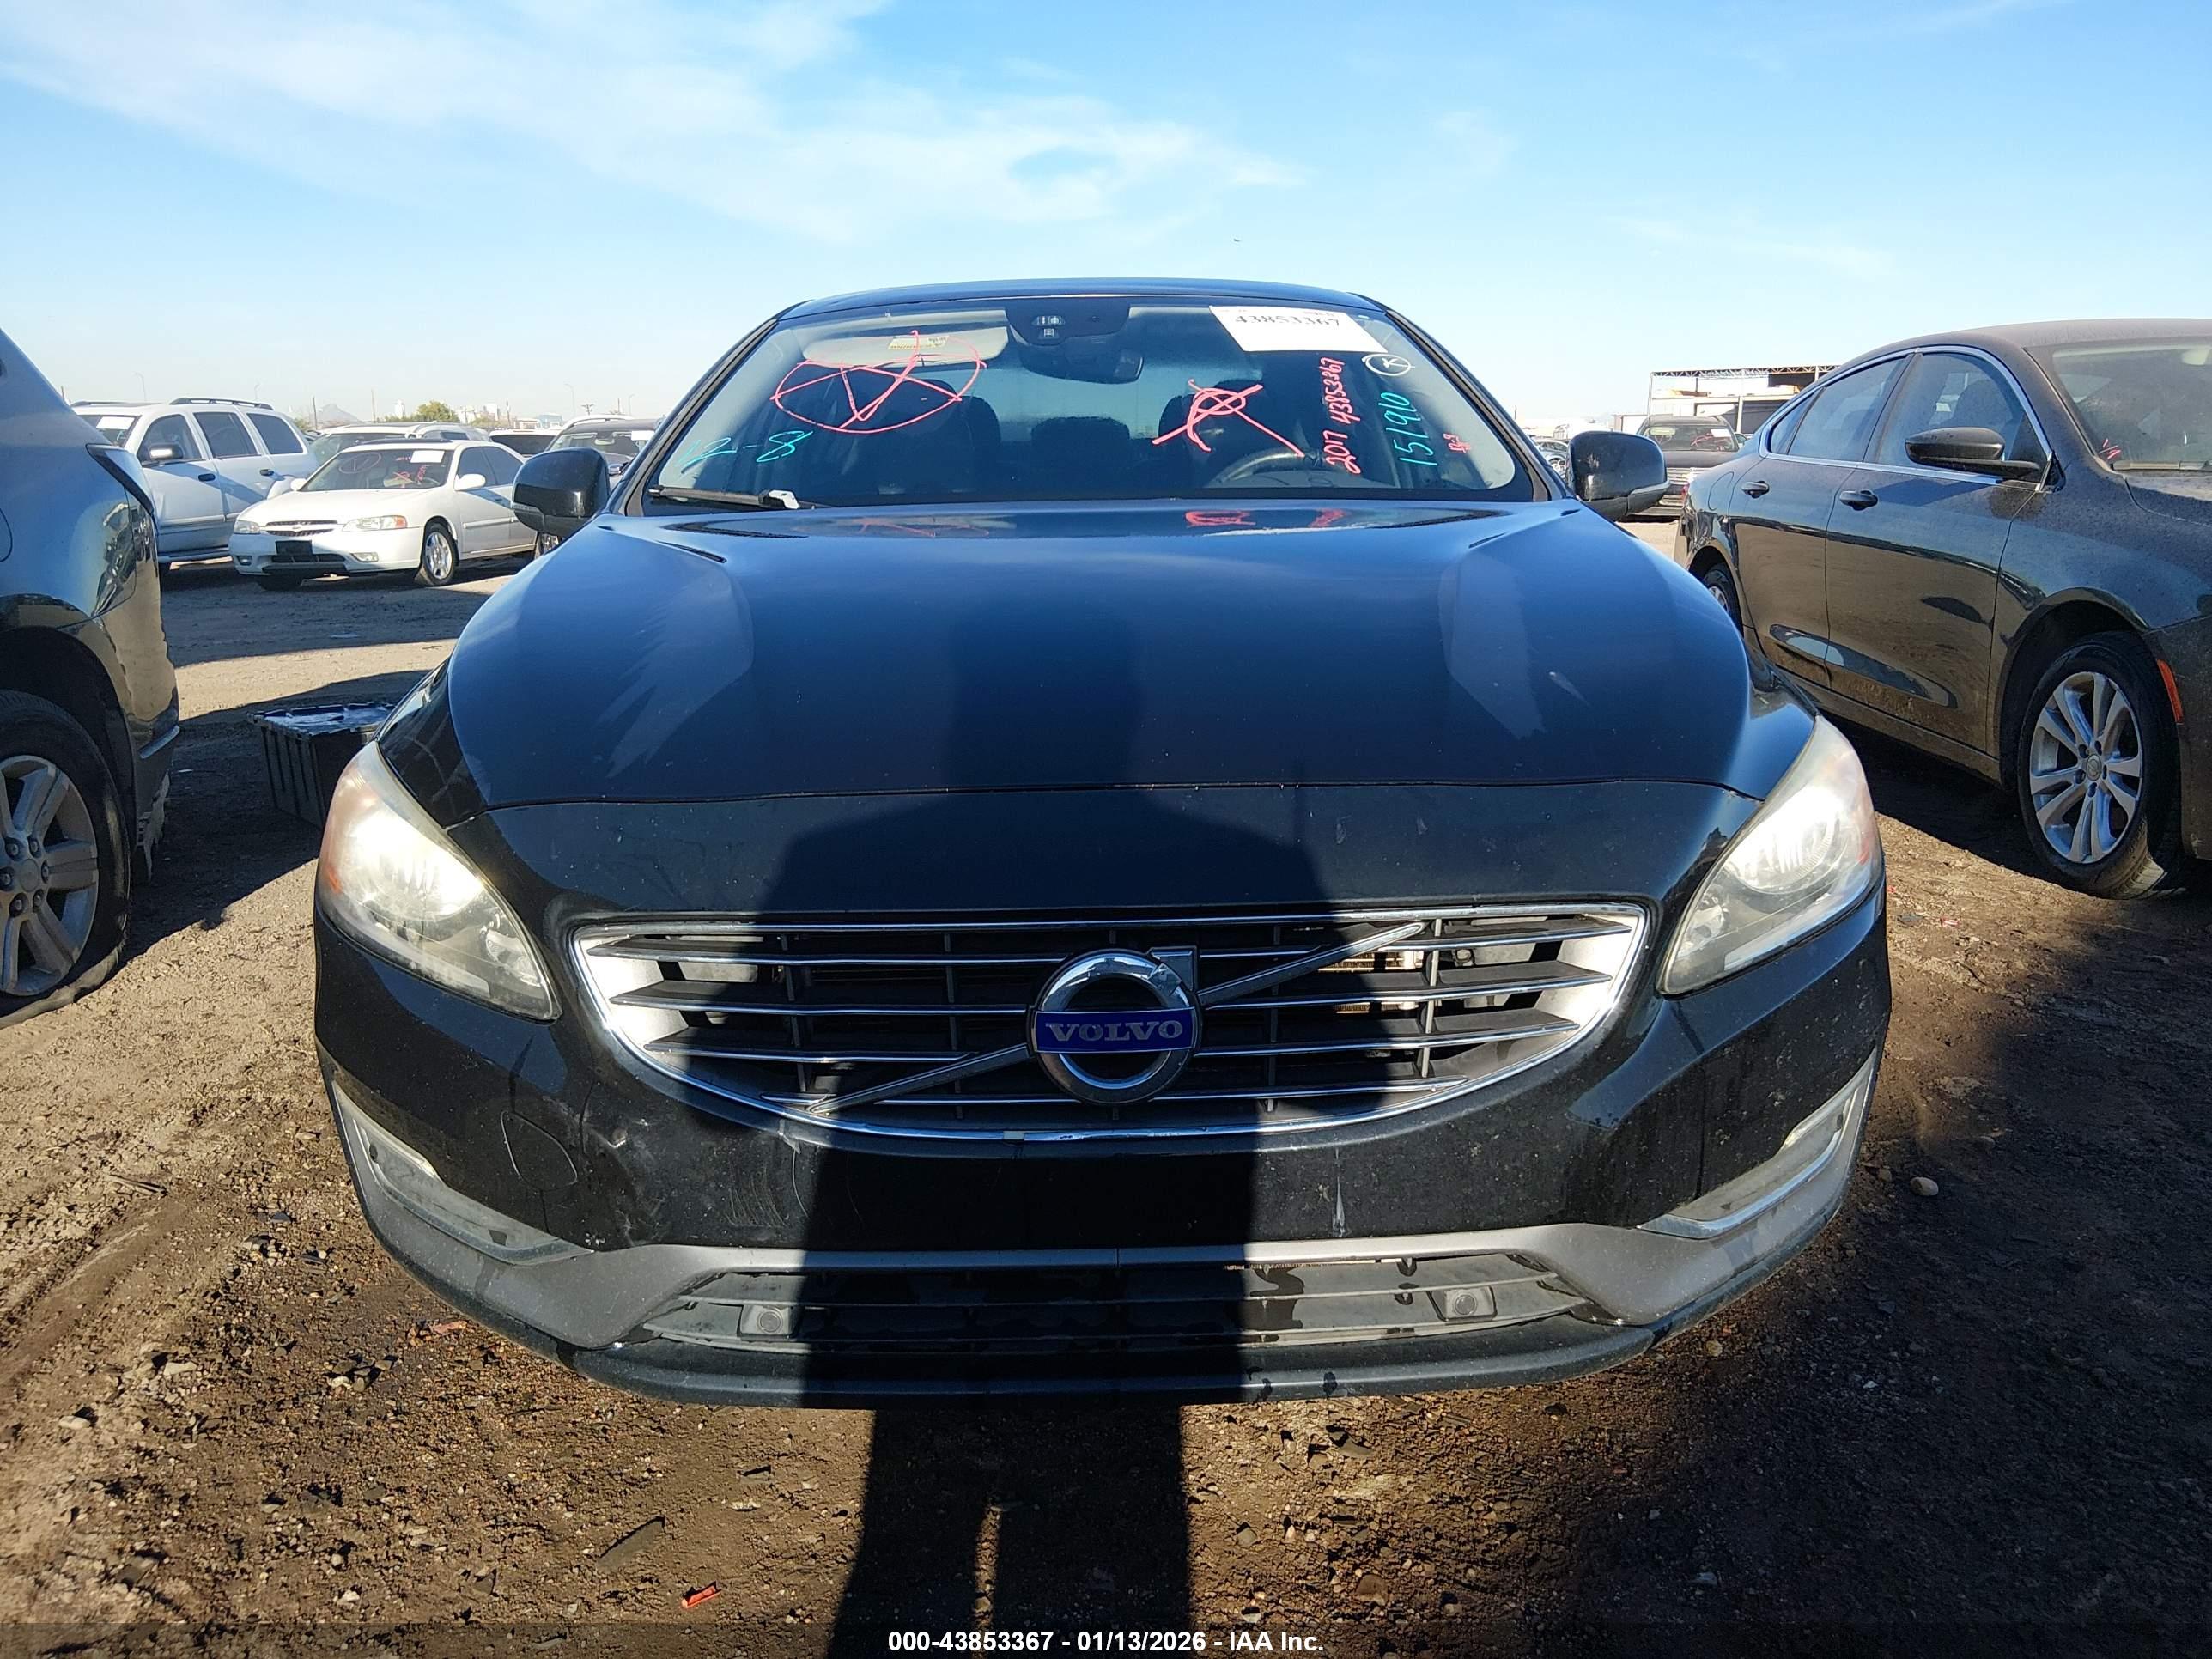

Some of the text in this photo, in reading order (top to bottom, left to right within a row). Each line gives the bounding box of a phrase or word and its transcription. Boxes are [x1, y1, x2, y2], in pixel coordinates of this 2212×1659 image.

[1235, 315, 1340, 327] 43853367
[1320, 357, 1362, 474] 2017 43853367
[1377, 392, 1438, 466] 151910
[1045, 1020, 1183, 1042] VOLVO
